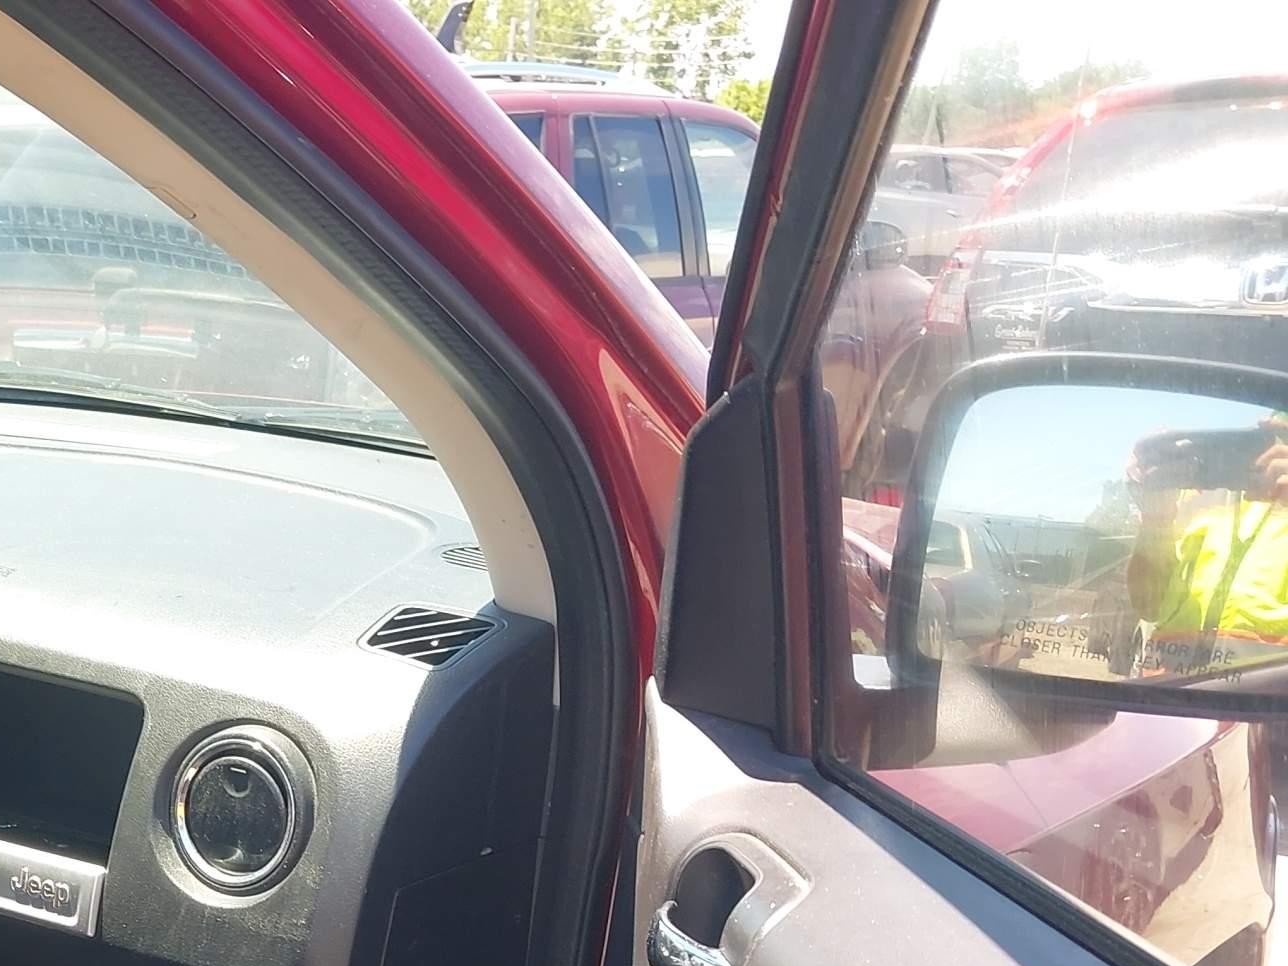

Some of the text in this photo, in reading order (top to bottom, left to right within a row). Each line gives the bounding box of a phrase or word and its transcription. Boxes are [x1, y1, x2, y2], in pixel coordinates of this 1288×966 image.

[1015, 619, 1089, 641] OBJECTS
[999, 633, 1062, 656] CLOSER
[10, 865, 70, 908] Jeep
